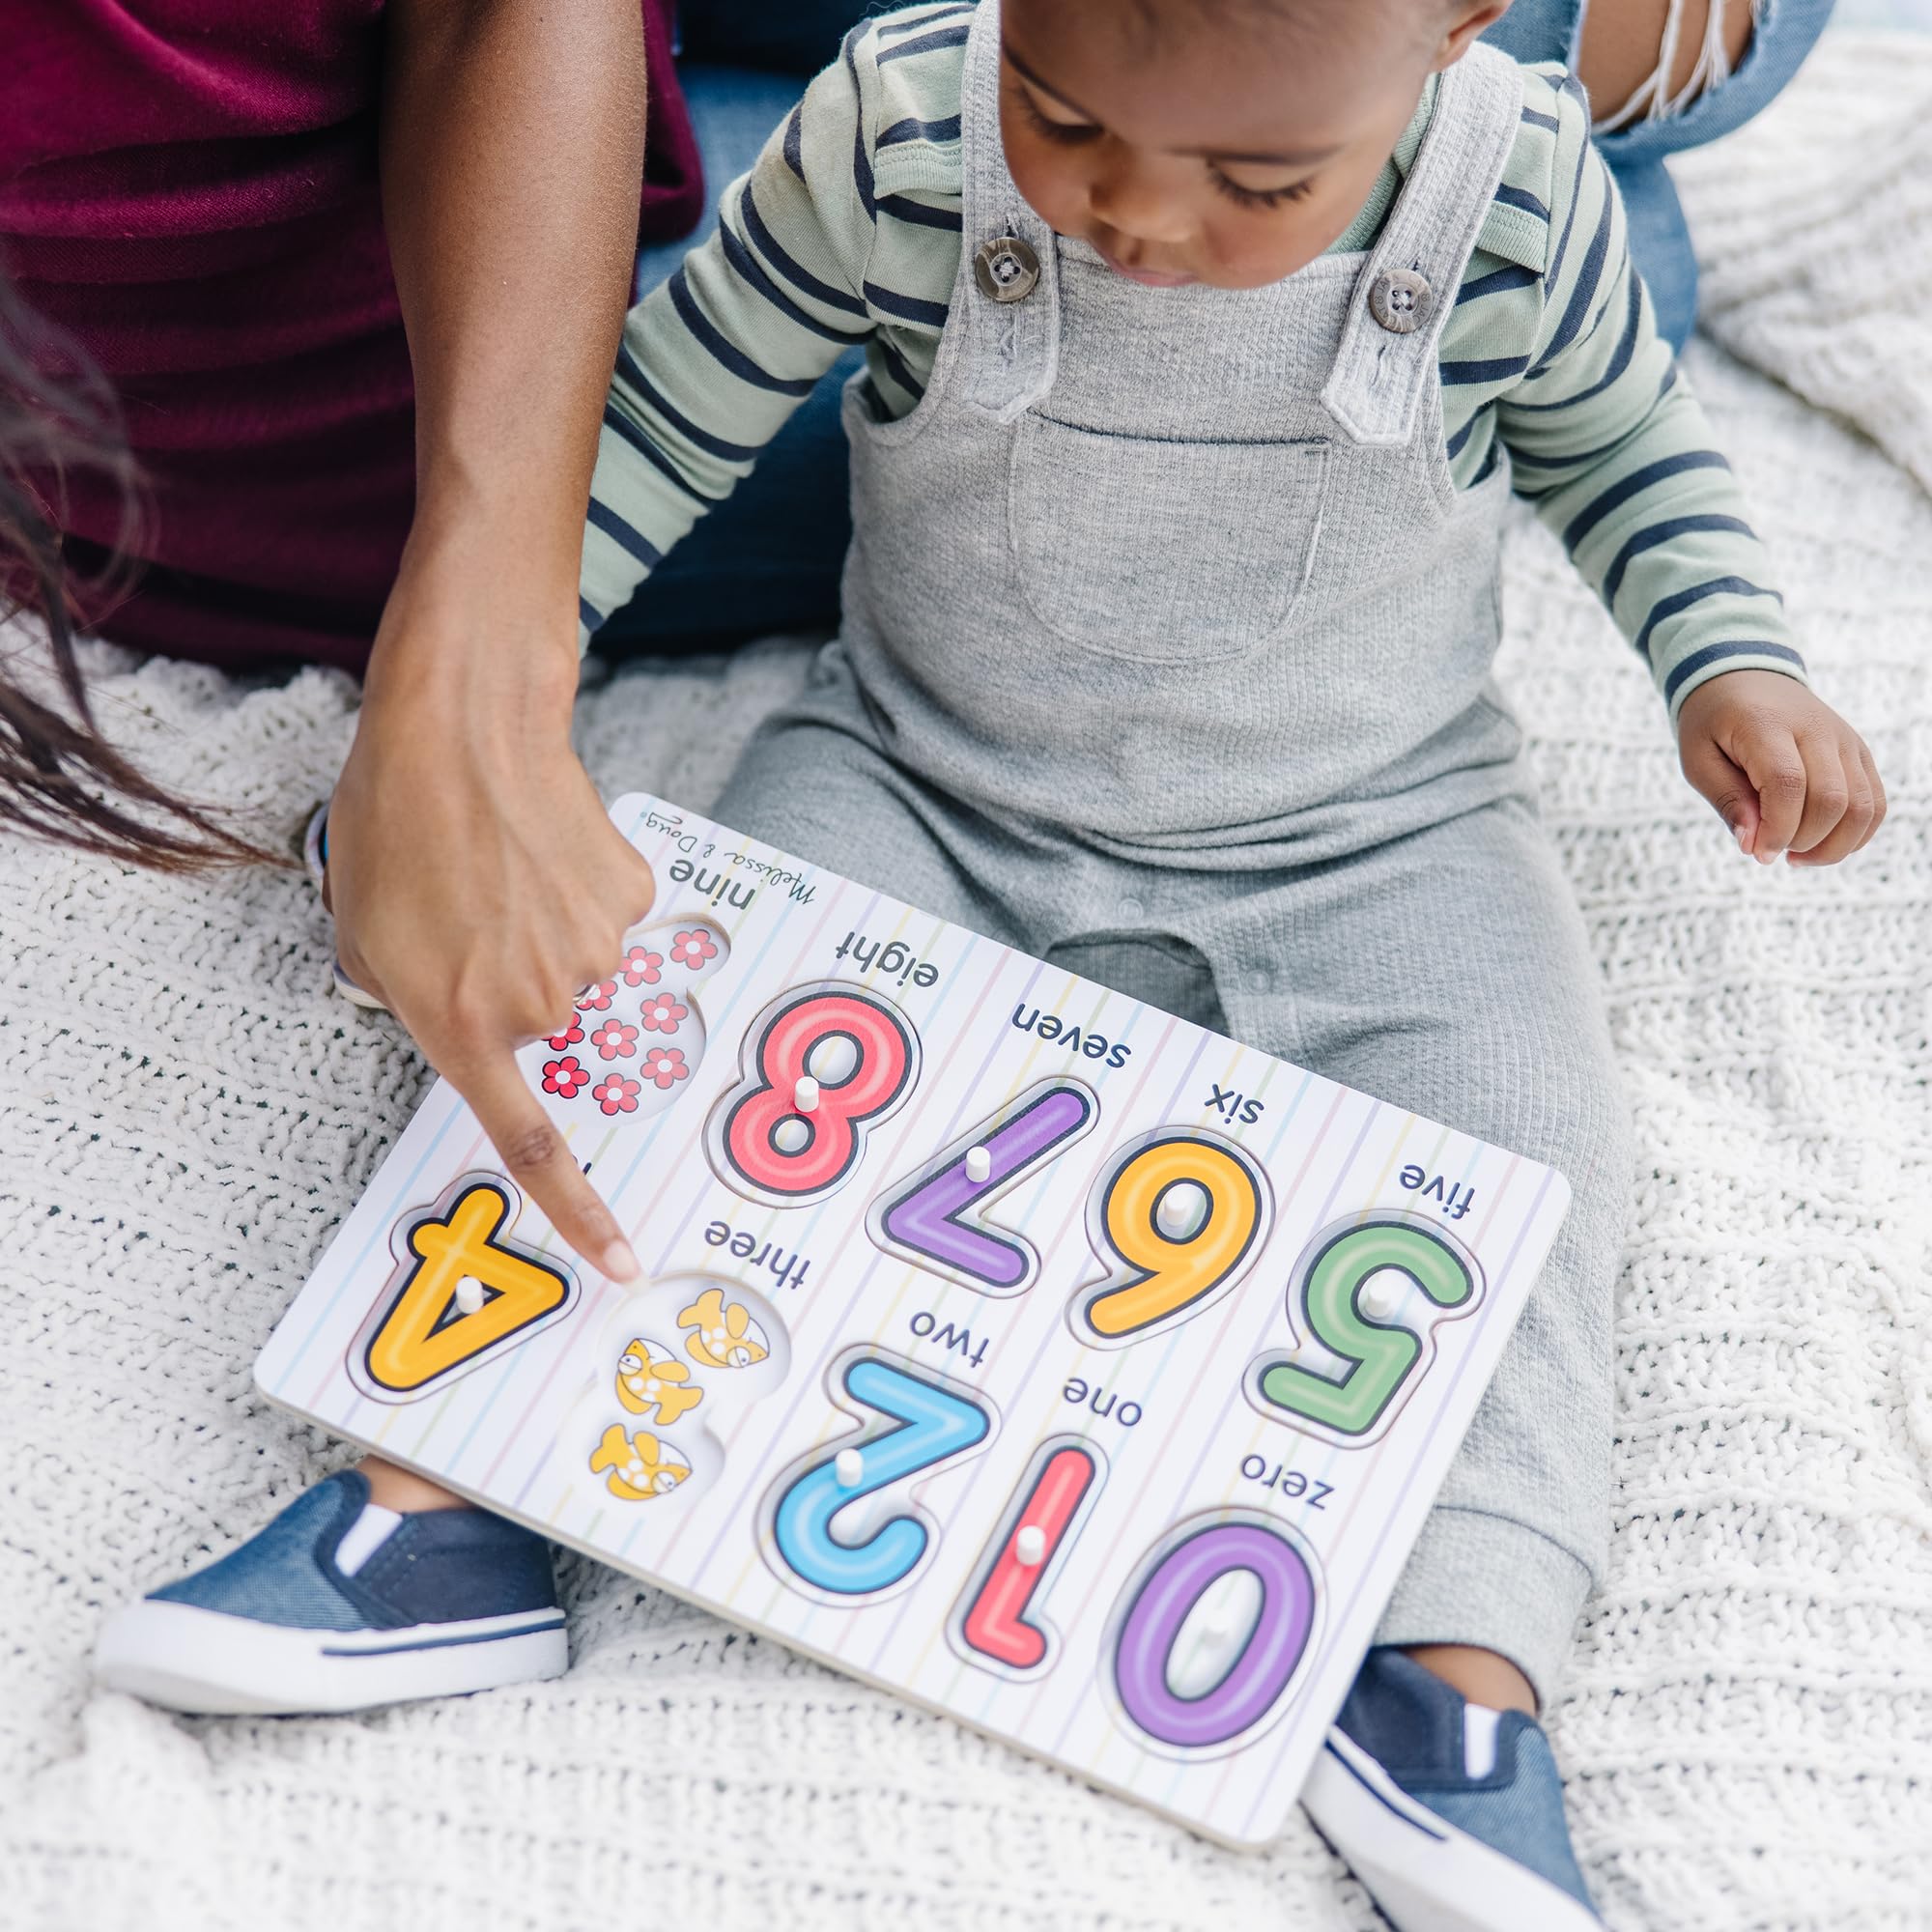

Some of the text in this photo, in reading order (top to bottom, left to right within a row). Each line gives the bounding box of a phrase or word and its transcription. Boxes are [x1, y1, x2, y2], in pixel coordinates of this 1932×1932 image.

[703, 843, 716, 858] &
[724, 852, 816, 904] Melissa
[669, 859, 755, 910] nine
[836, 931, 939, 988] eight
[1011, 1003, 1132, 1068] seven
[723, 991, 912, 1197] 8
[1204, 1083, 1264, 1124] six
[881, 1086, 1091, 1288] 7
[1399, 1164, 1476, 1220] five
[704, 1220, 811, 1290] three
[1086, 1136, 1263, 1340] 6
[364, 1182, 570, 1392] 4
[910, 1312, 990, 1369] two
[1259, 1221, 1472, 1436] 5
[1063, 1378, 1143, 1427] one
[775, 1357, 991, 1595] 2
[1240, 1454, 1335, 1510] zero
[965, 1445, 1095, 1669] 1
[1116, 1521, 1316, 1747] 0
